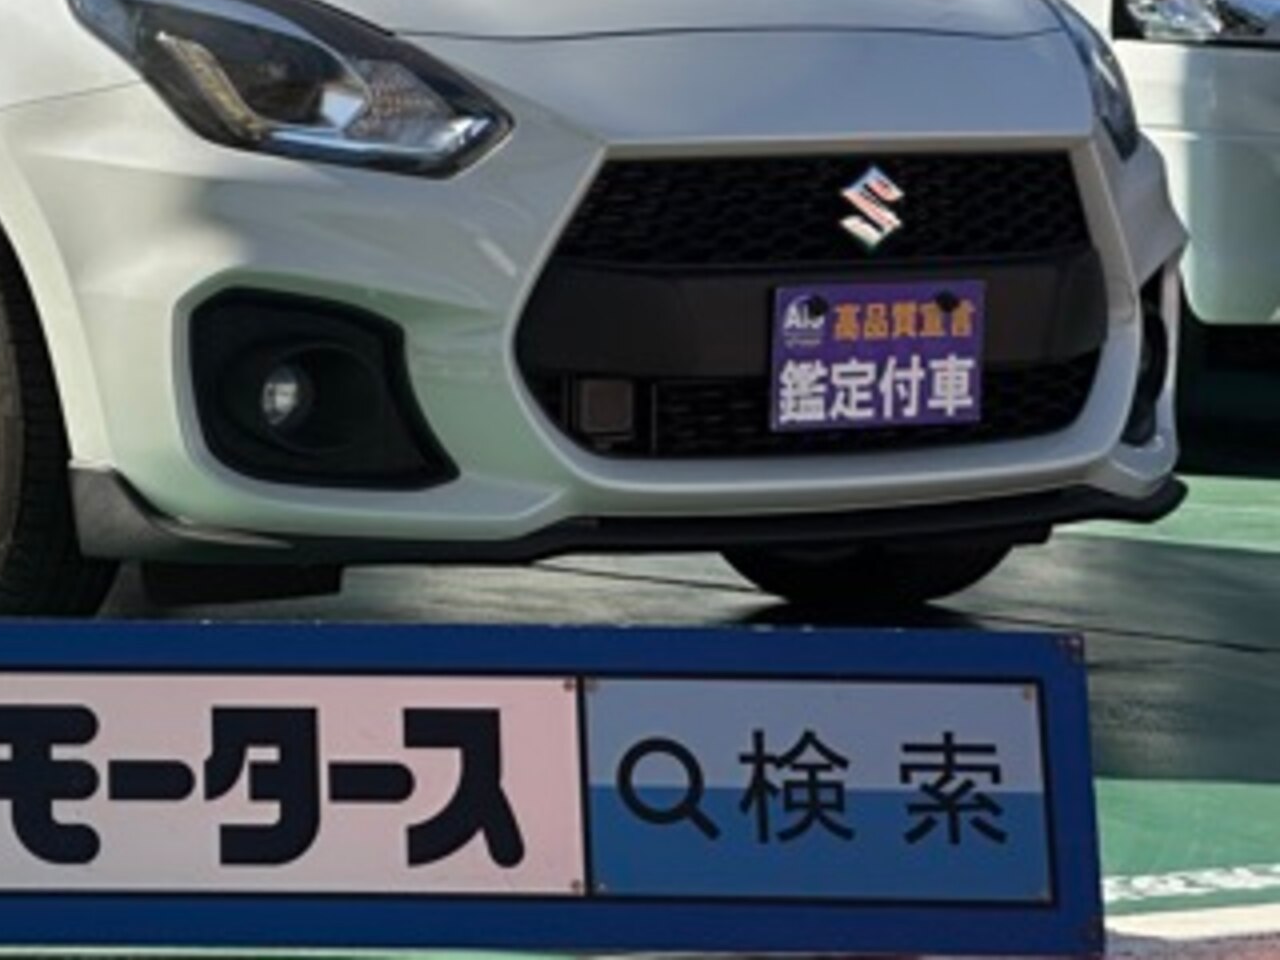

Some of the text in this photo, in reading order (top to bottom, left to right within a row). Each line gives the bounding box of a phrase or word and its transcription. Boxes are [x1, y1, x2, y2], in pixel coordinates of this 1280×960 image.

[779, 355, 975, 424] 鑑定付車
[738, 729, 1008, 844] 検索
